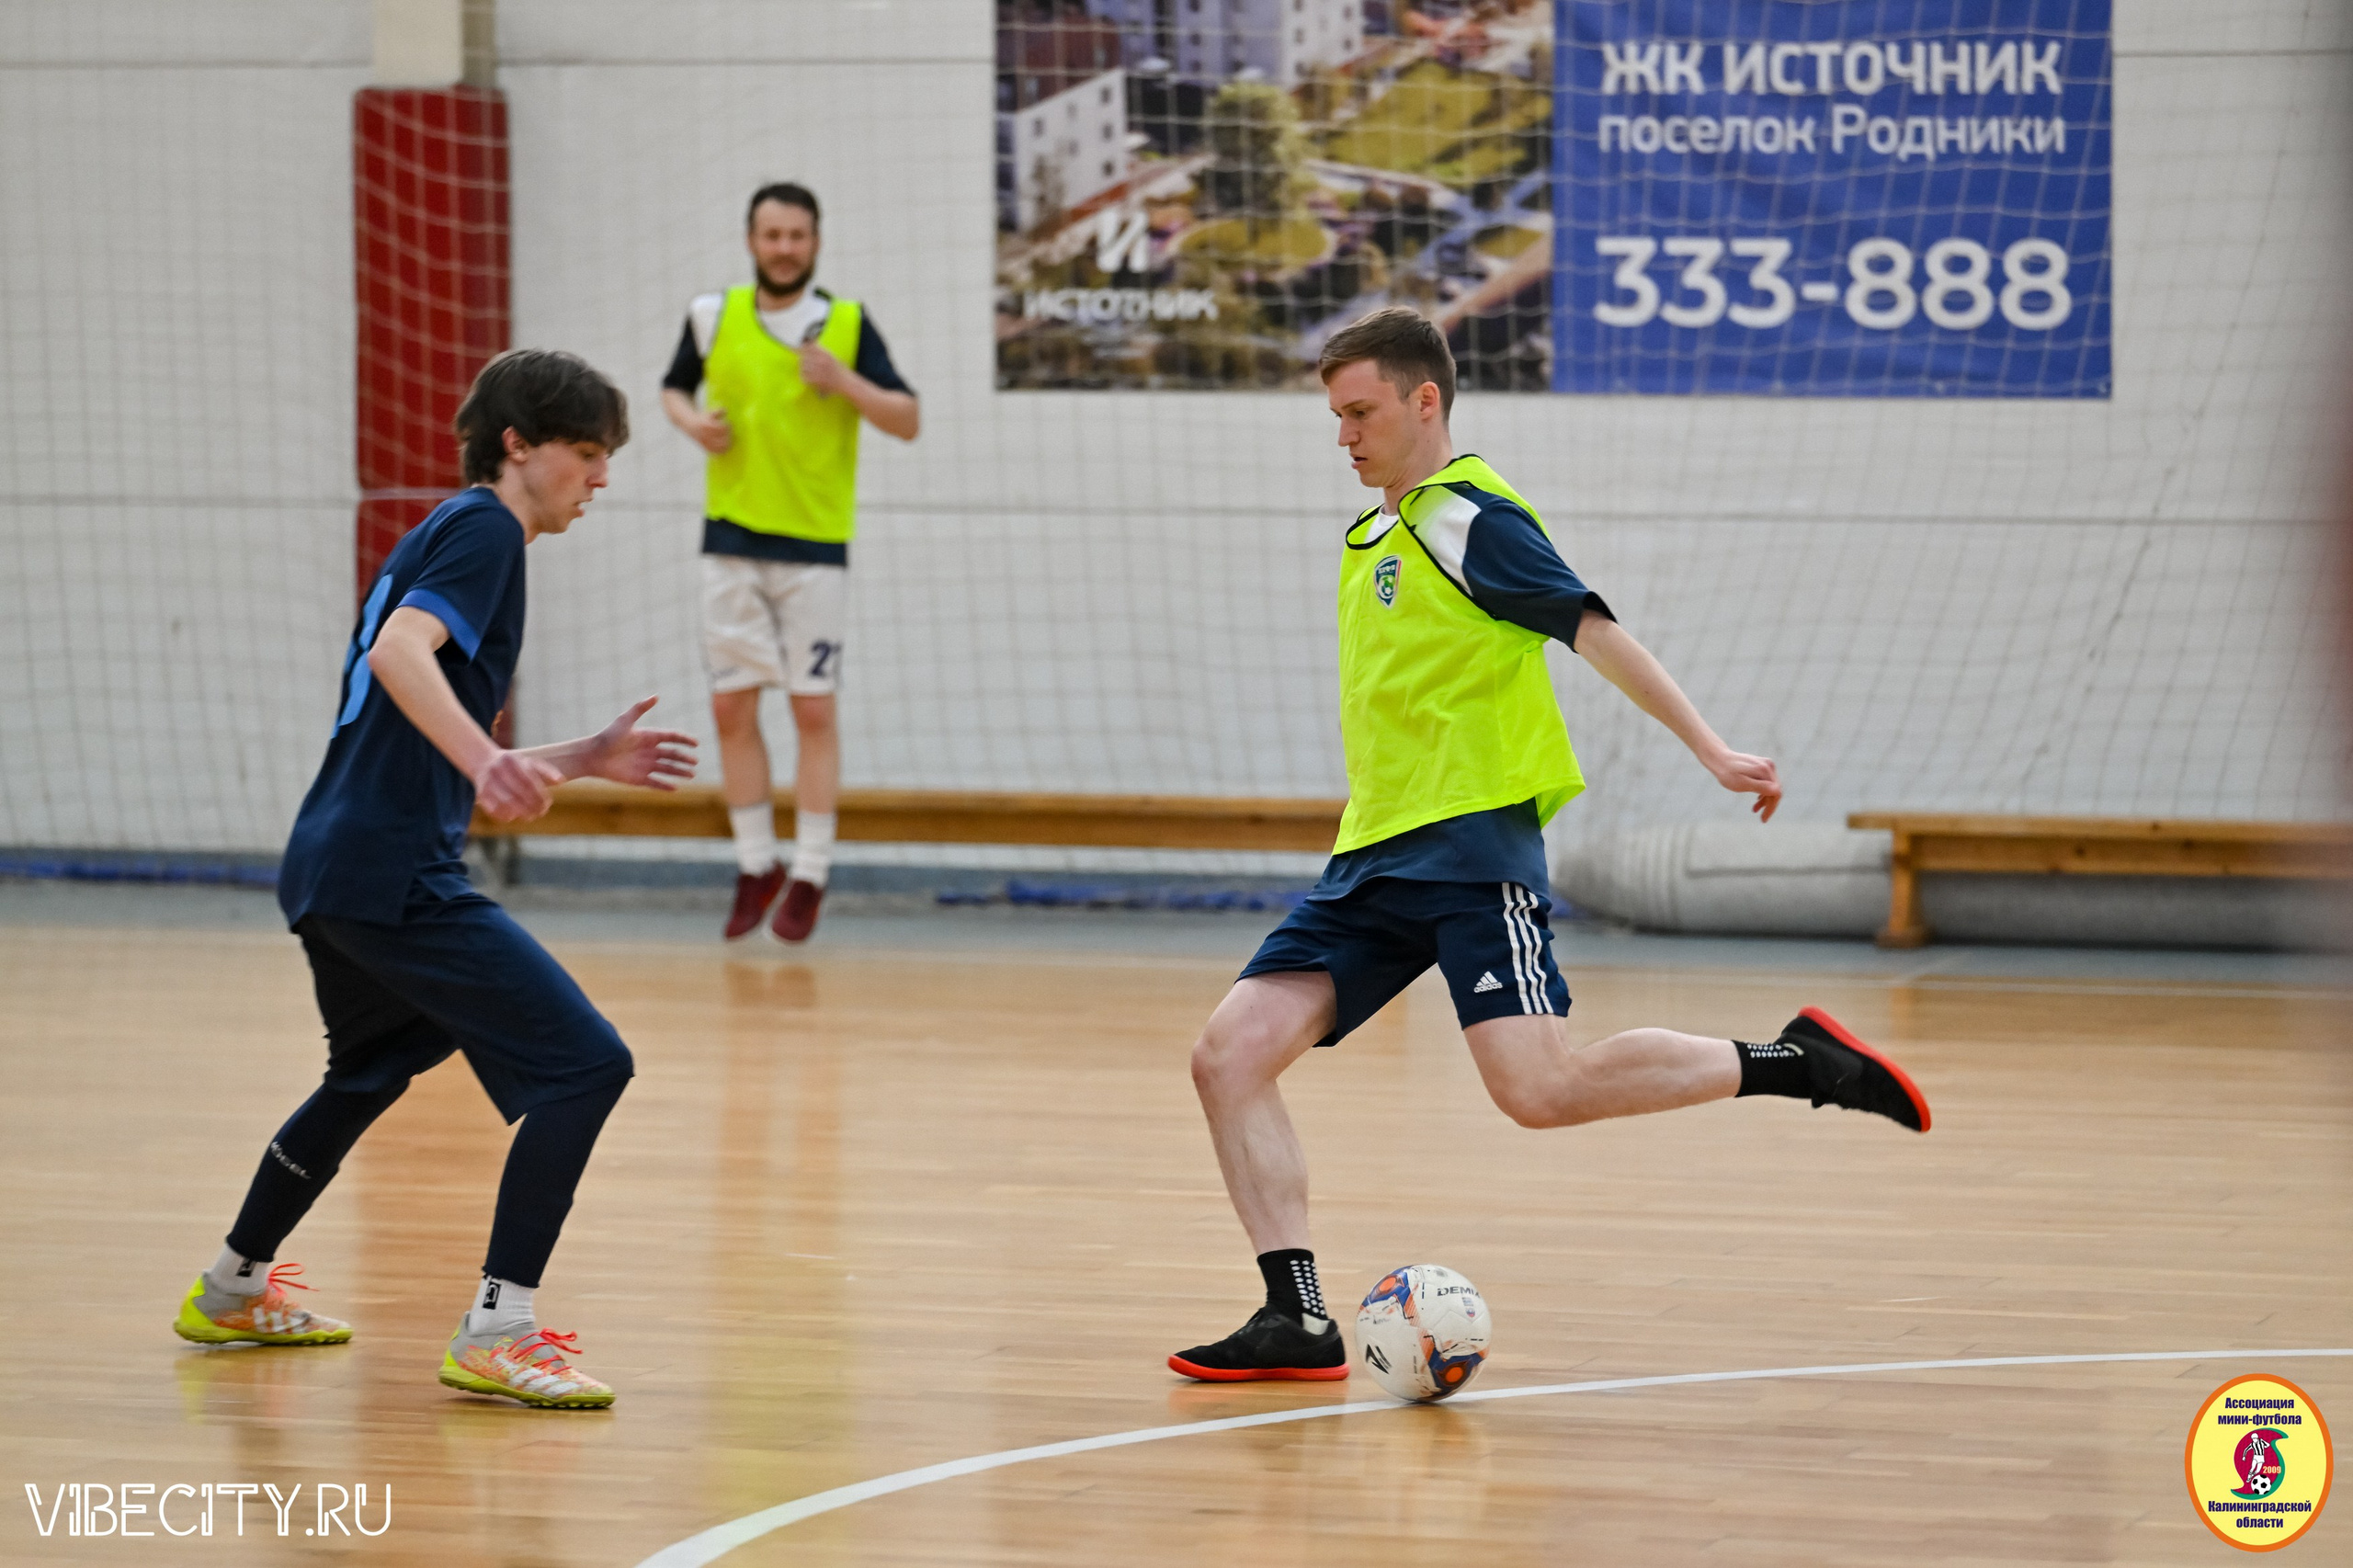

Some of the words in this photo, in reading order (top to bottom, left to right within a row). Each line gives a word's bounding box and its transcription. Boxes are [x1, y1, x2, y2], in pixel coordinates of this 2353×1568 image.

[1602, 41, 1704, 94] ЖК
[1723, 41, 2062, 95] ИСТОЧНИК
[1599, 115, 1816, 153] поселок
[1832, 104, 2066, 161] Родники
[1594, 236, 2072, 330] 333-888
[1473, 982, 1503, 994] adidas
